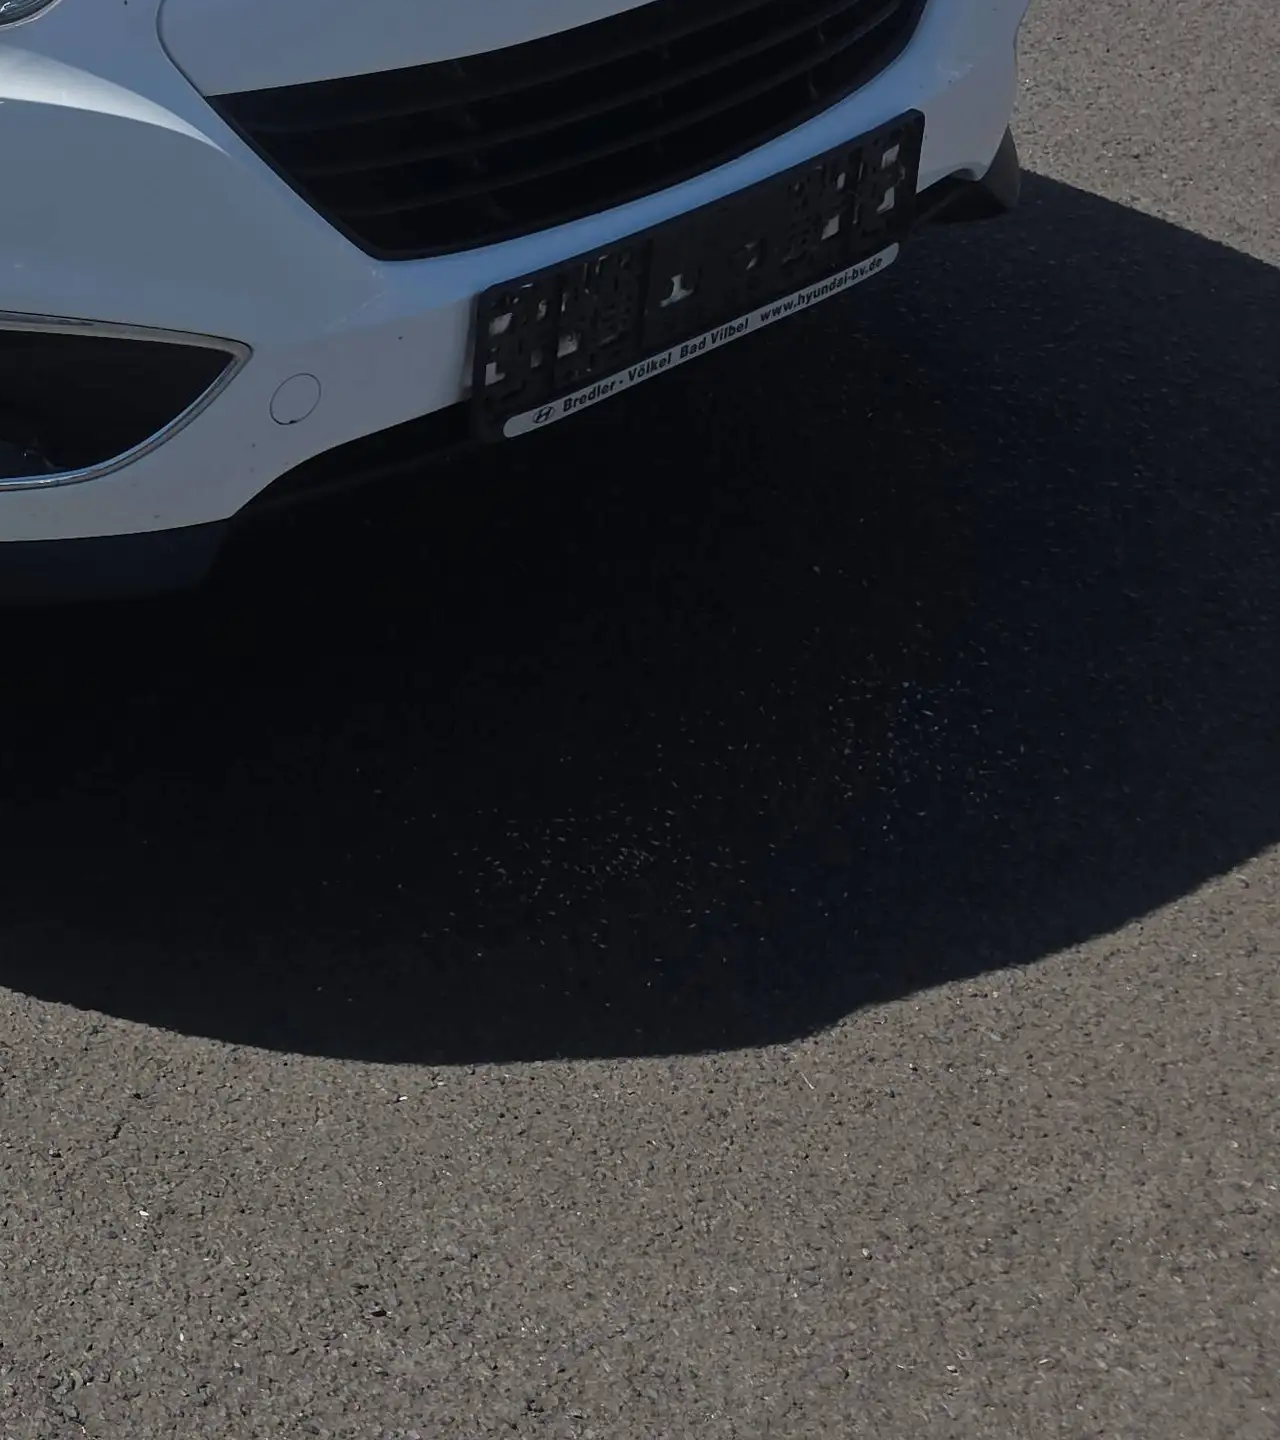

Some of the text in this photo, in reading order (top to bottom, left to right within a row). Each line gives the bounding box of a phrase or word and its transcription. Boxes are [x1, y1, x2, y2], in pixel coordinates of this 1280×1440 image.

[562, 379, 616, 412] Bredler
[628, 352, 673, 383] Völkel
[679, 338, 707, 360] Bad
[710, 317, 750, 344] Vilbel
[759, 257, 883, 322] www.hyundai-bv.de
